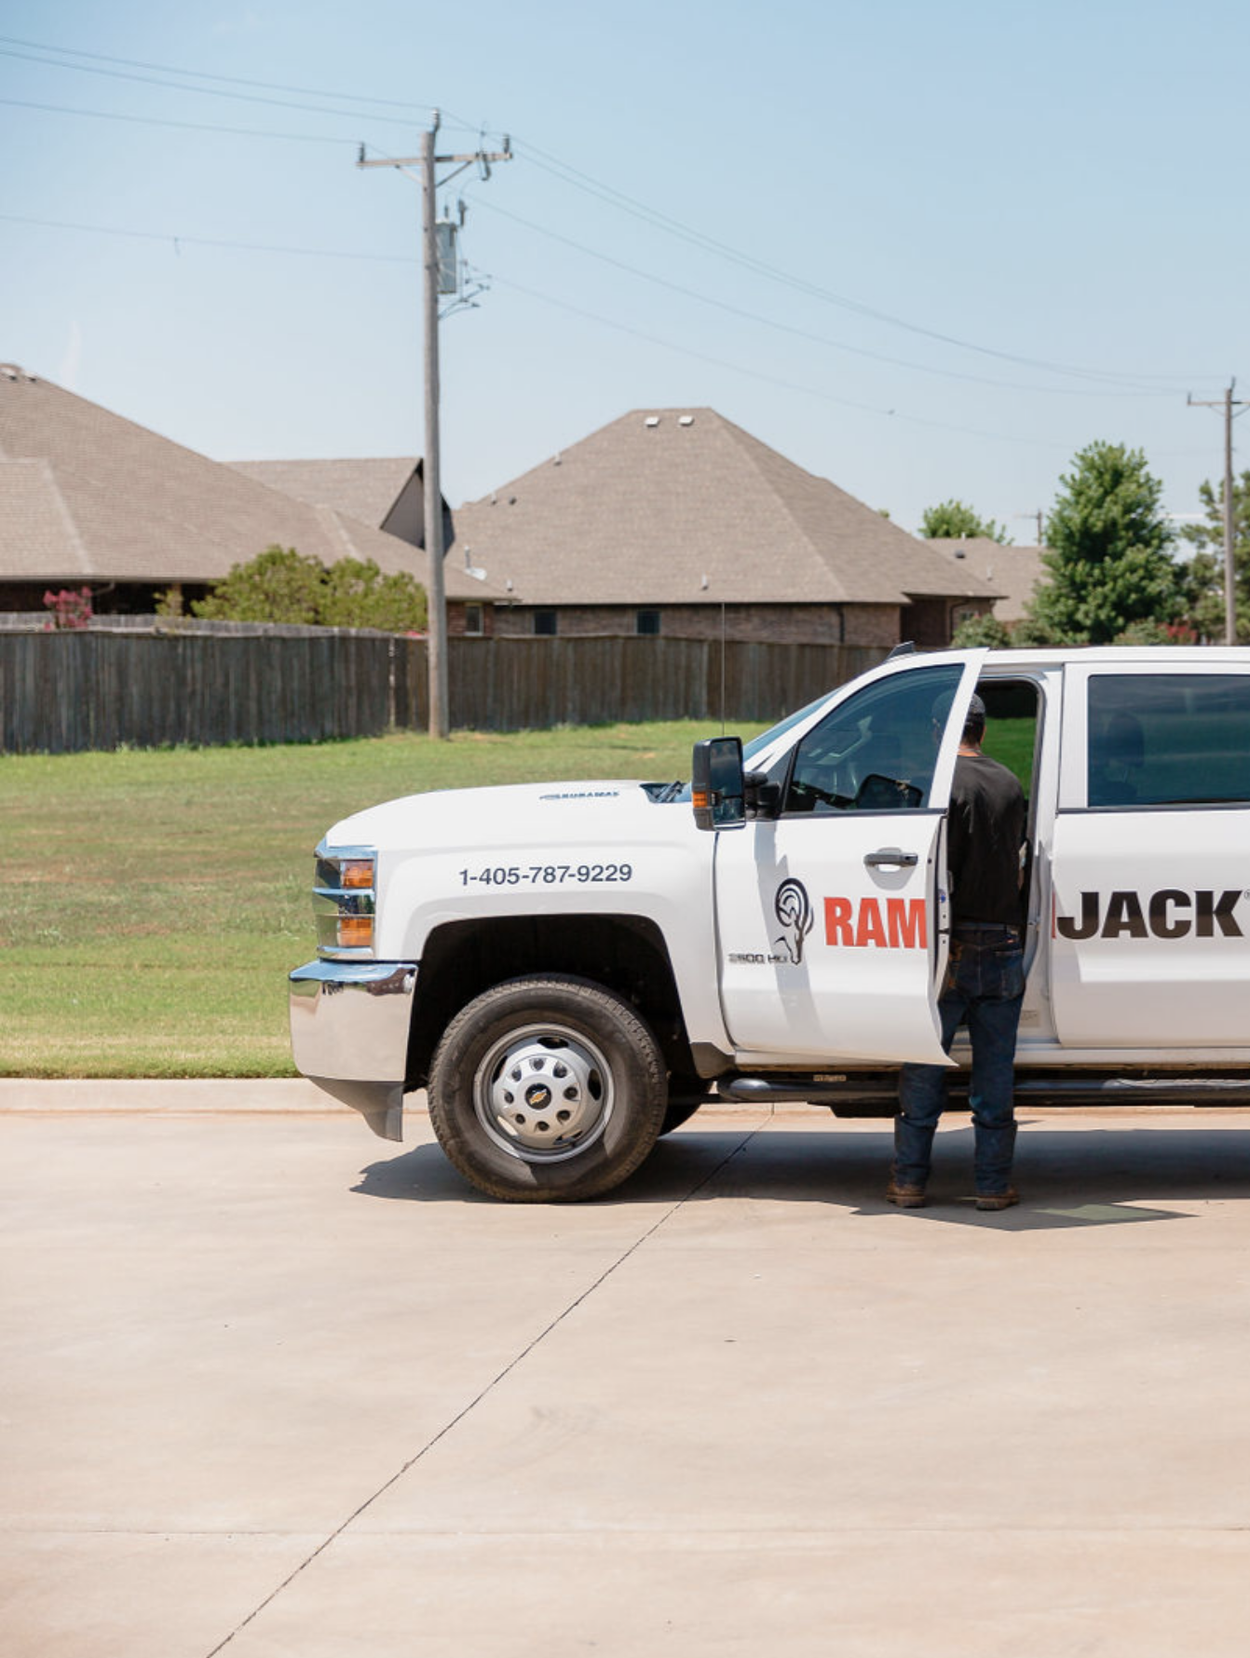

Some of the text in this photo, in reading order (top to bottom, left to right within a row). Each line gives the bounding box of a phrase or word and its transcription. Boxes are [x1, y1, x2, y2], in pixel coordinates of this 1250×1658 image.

[459, 863, 633, 886] 1-405-787-9229
[824, 889, 1245, 949] RAM JACK
